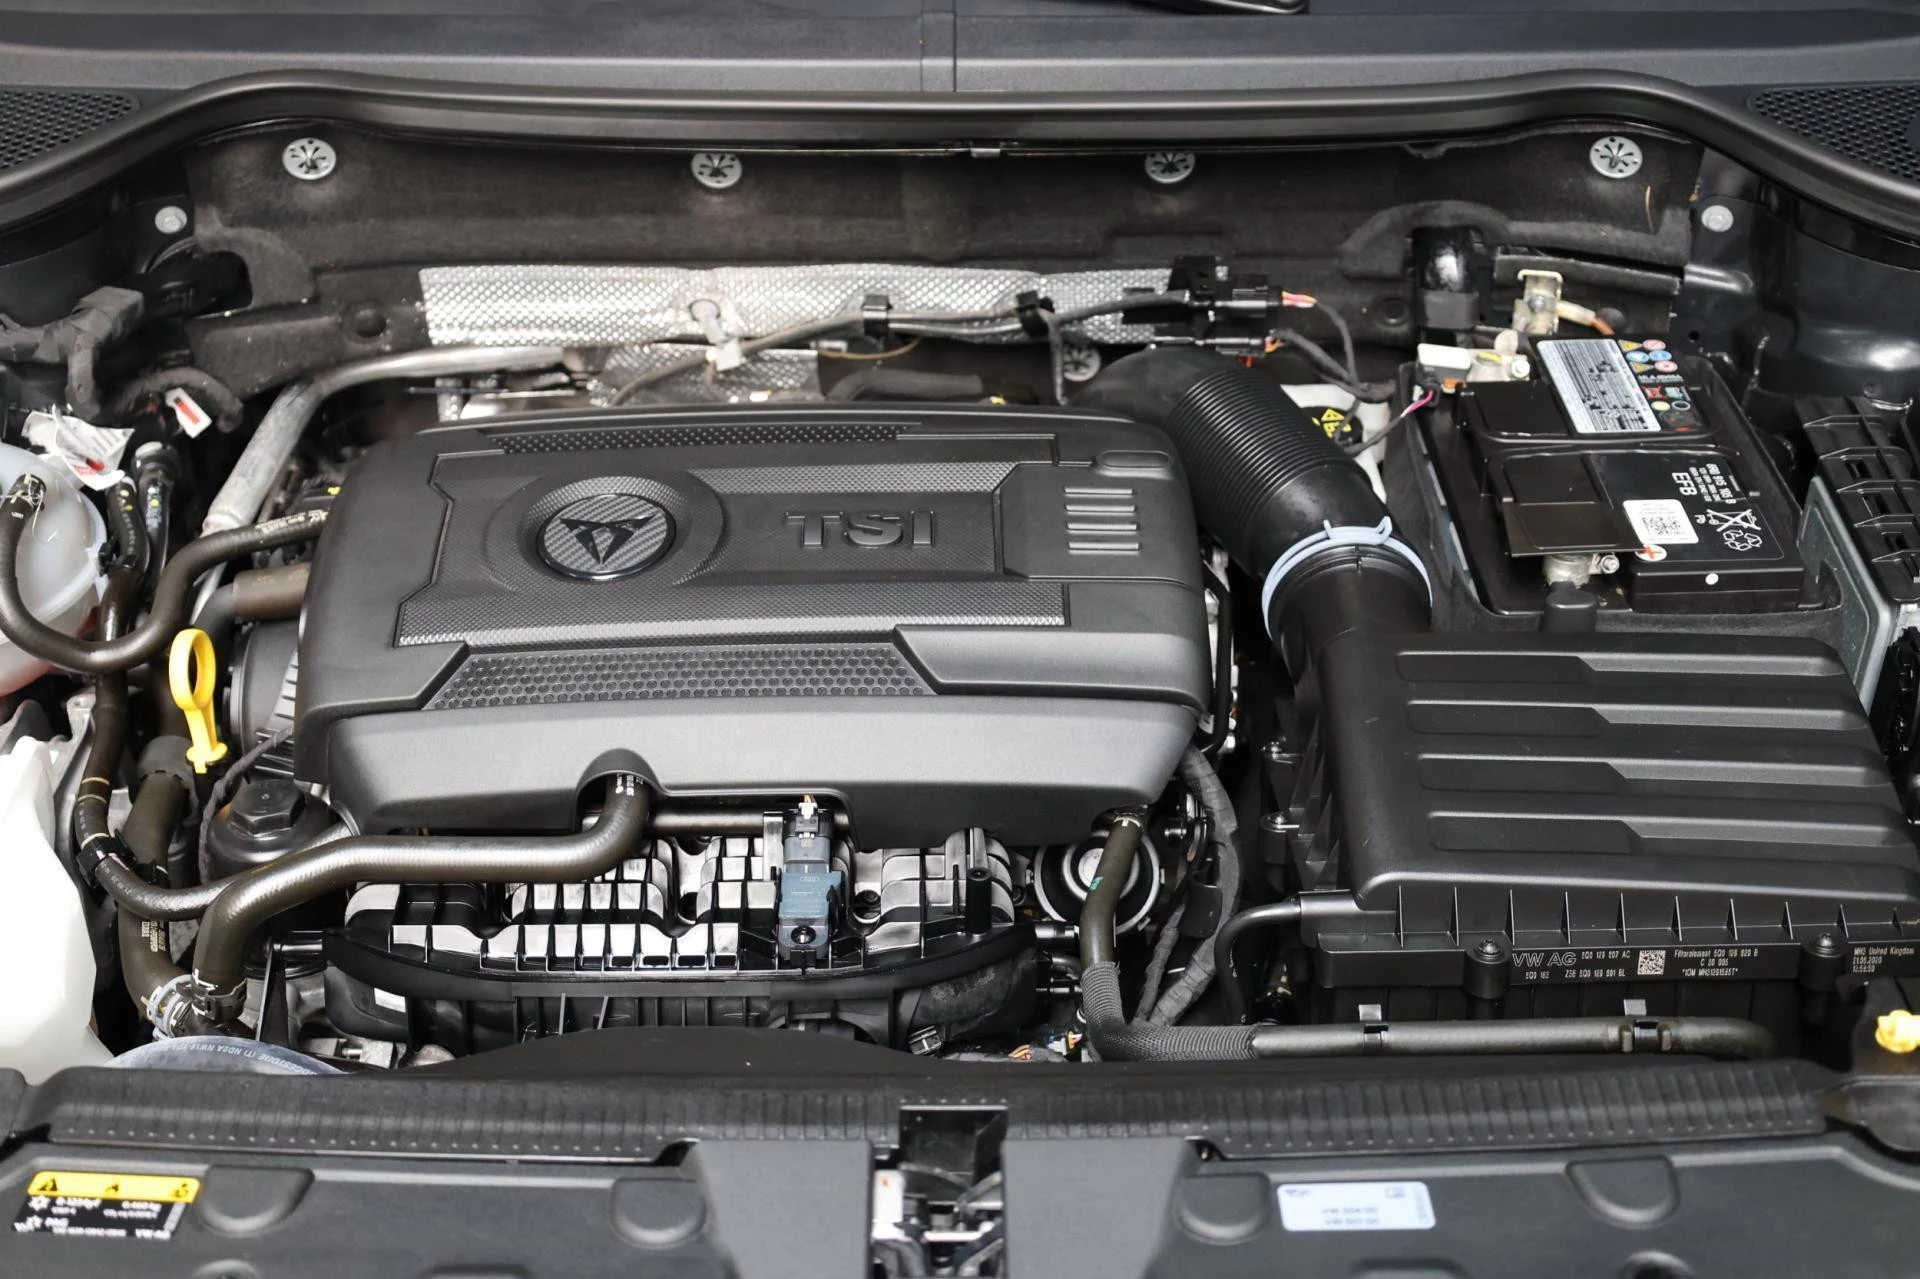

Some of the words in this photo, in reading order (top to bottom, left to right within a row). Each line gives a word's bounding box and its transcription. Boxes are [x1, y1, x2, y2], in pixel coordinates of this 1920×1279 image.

[1672, 472, 1698, 496] EFB
[786, 511, 934, 549] TSI
[1512, 952, 1544, 967] VW
[1547, 951, 1577, 966] AG
